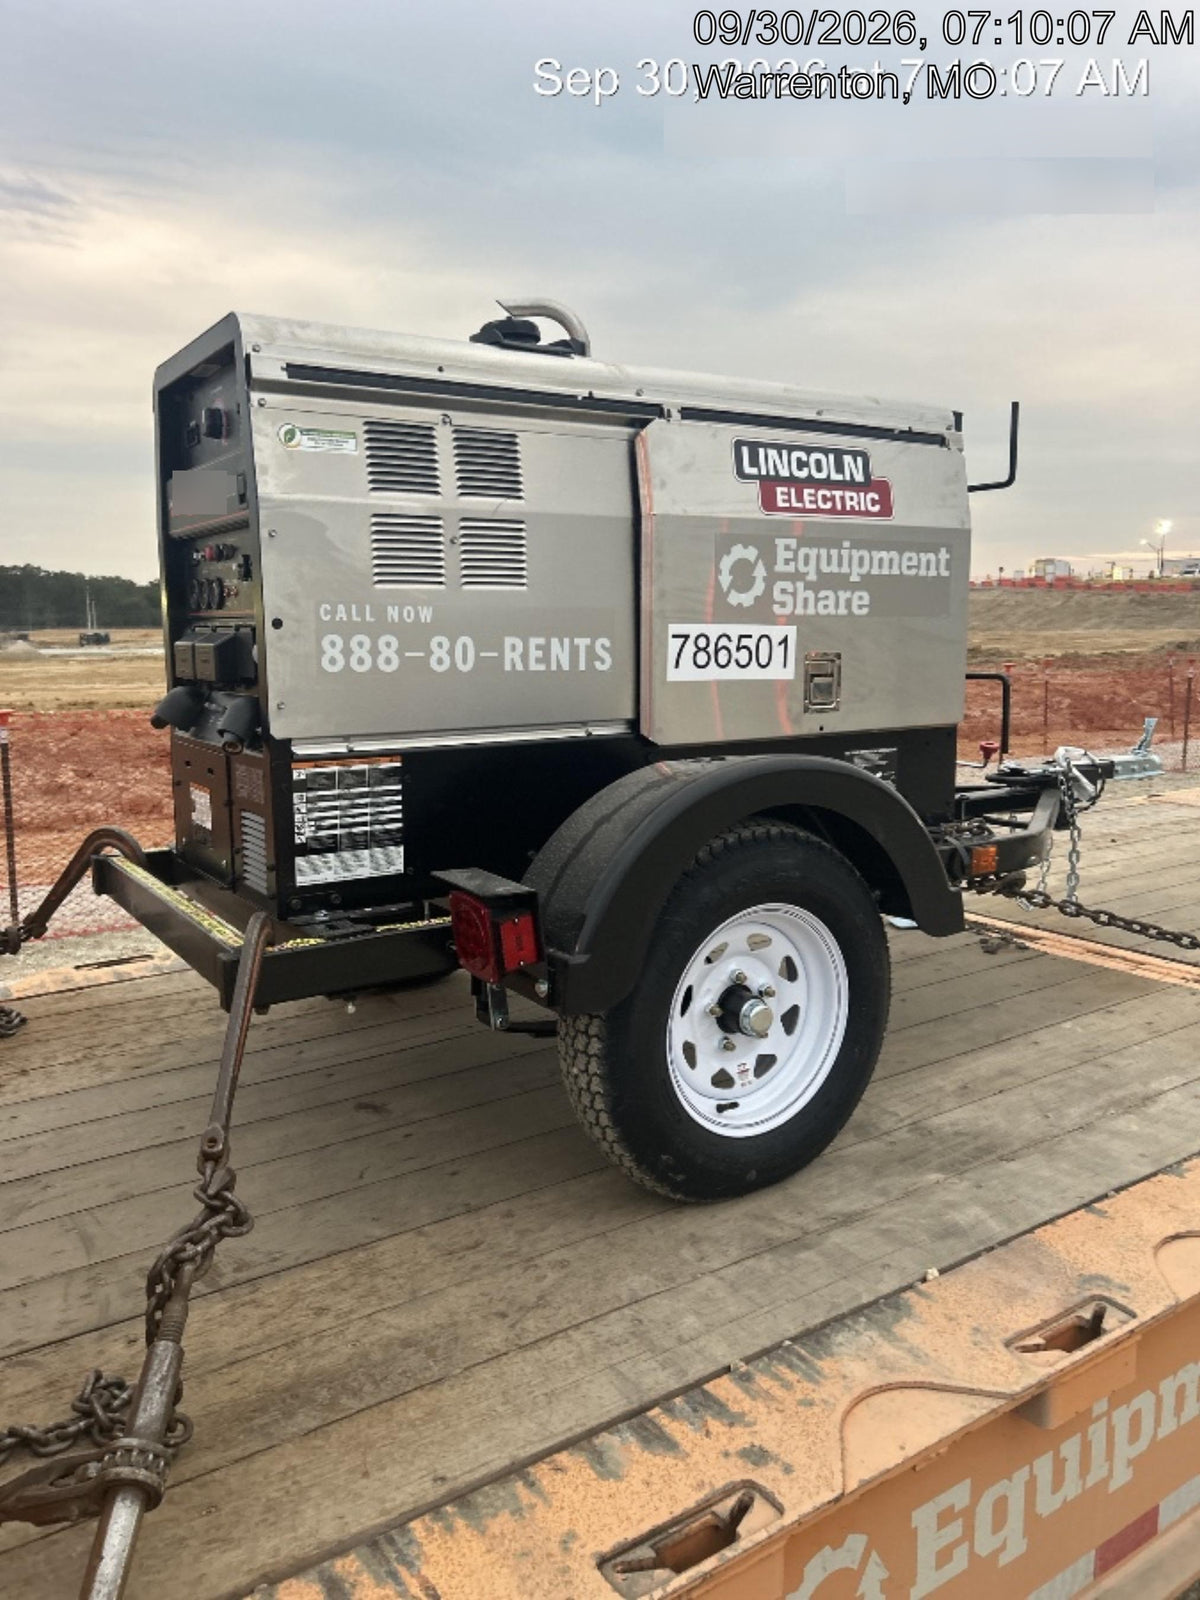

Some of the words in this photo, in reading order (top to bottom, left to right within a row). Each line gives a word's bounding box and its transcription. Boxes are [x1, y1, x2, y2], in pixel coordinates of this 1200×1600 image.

[741, 445, 865, 483] LINCOLN
[775, 486, 881, 513] ELECTRIC
[774, 537, 951, 582] Equipment
[319, 603, 376, 622] CALL
[387, 605, 434, 623] NOW
[772, 580, 871, 617] Share
[320, 634, 613, 673] 888-80-RENTS
[671, 633, 790, 669] 786501
